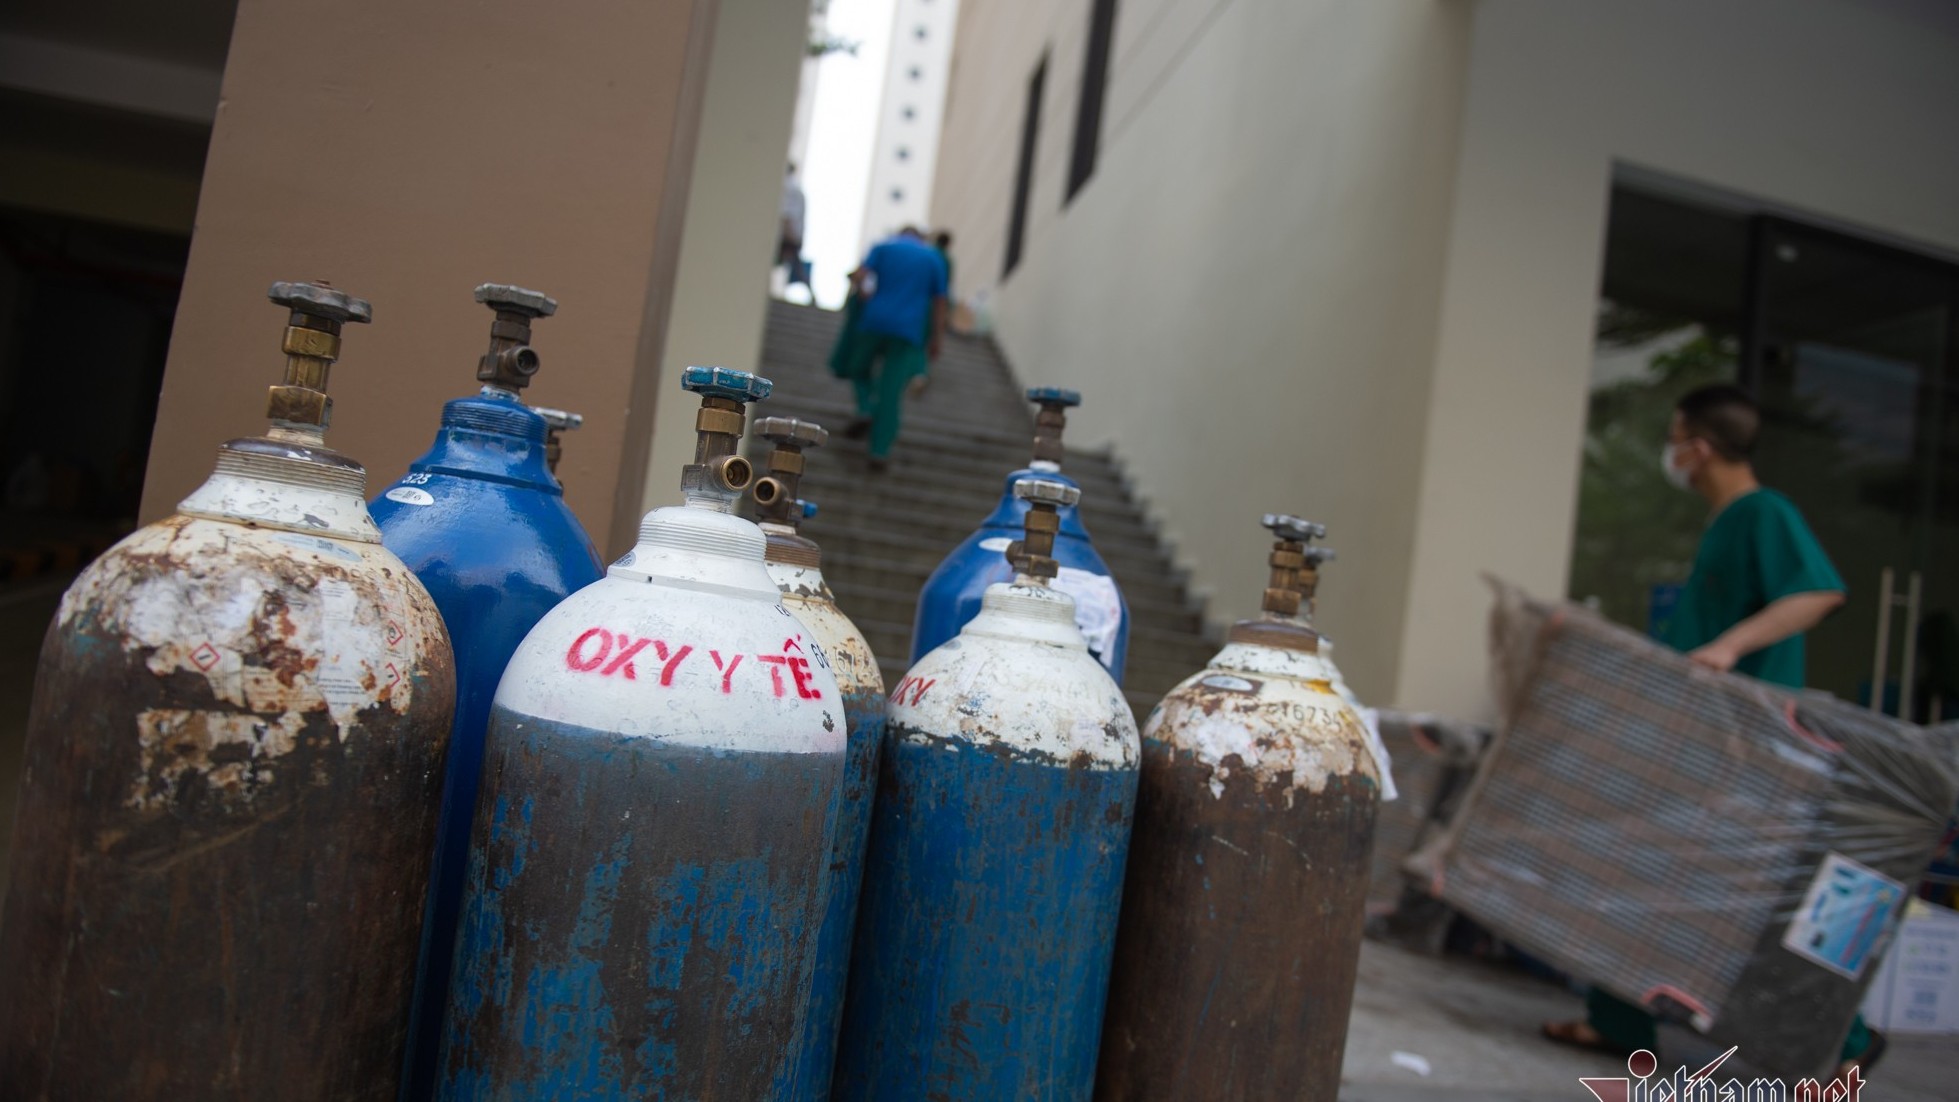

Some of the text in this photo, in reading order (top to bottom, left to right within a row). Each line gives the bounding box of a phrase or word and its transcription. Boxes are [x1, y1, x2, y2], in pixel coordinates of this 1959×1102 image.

[566, 627, 822, 700] OXY Y TẾ
